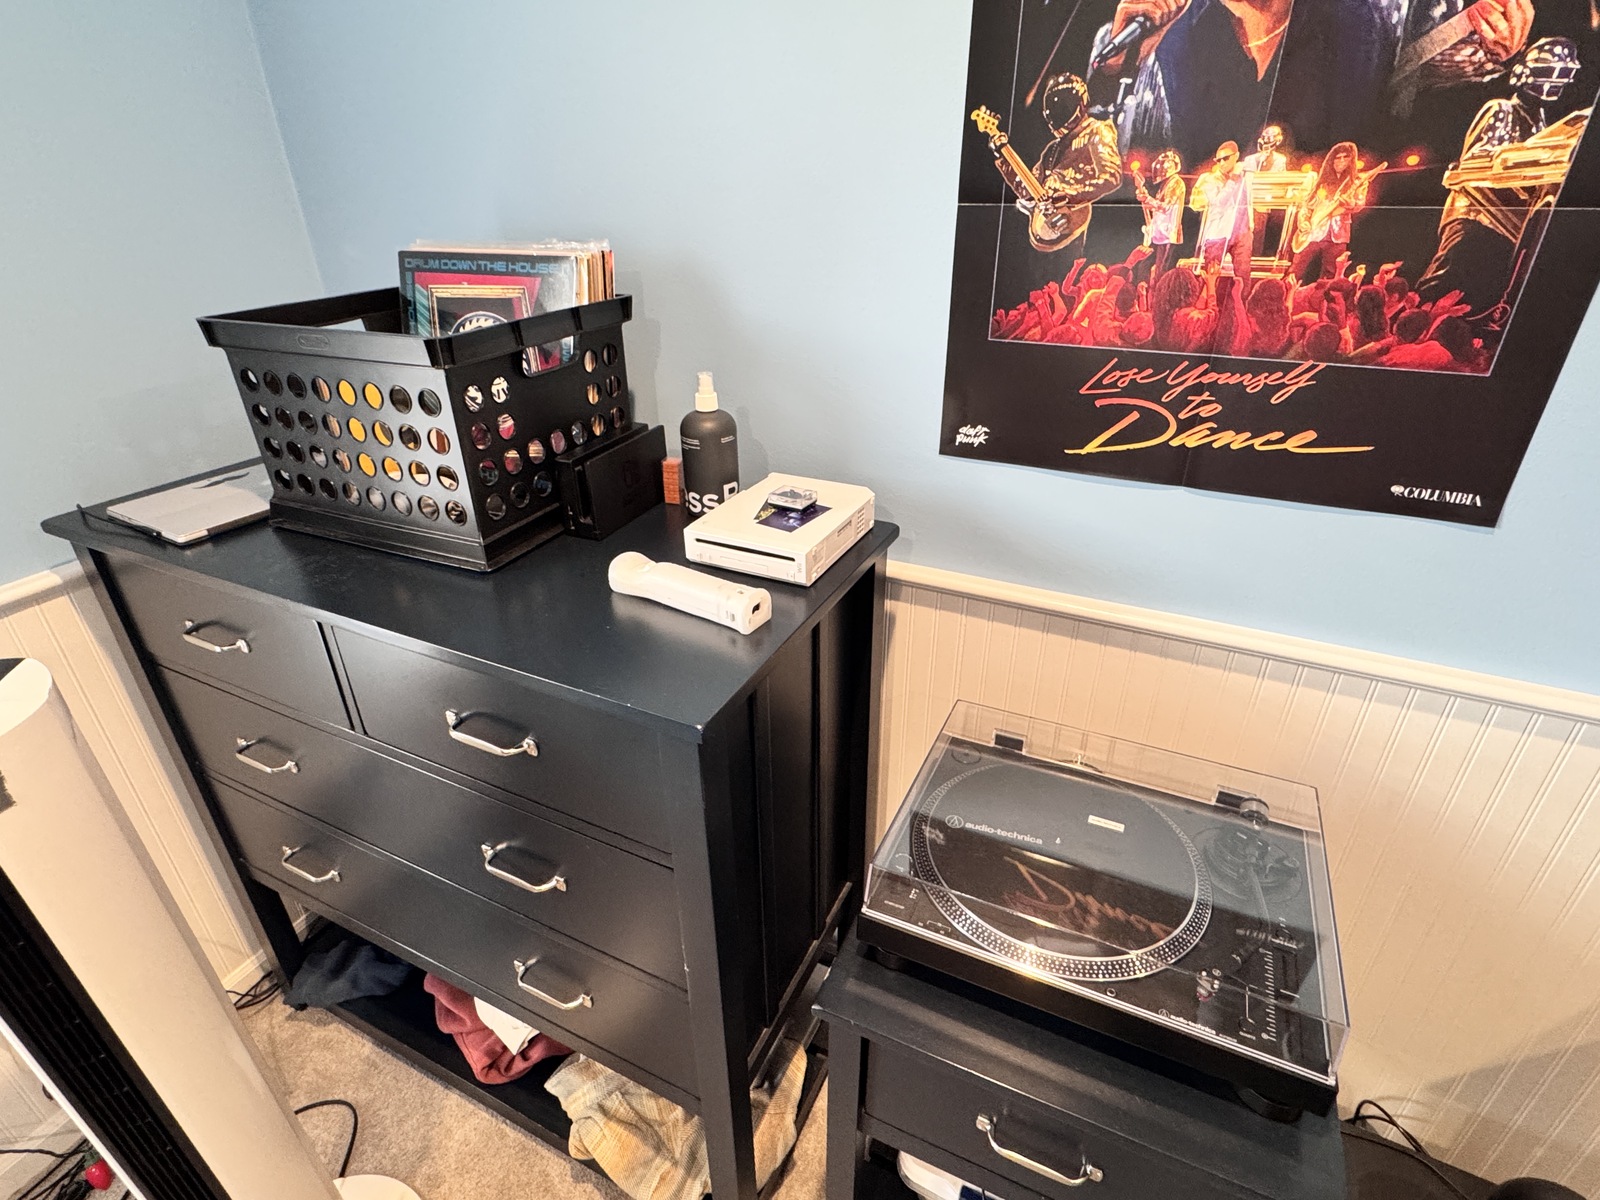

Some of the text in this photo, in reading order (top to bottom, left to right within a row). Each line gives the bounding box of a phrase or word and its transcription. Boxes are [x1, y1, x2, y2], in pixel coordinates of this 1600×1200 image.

[404, 258, 560, 274] DRUM DOWN THE HOUSE
[1079, 358, 1327, 404] Lose Yourself
[1178, 391, 1223, 419] to
[1065, 397, 1375, 454] Dance
[955, 433, 989, 447] punk
[1403, 486, 1482, 507] COLUMBIA
[964, 821, 1043, 845] audio-technica
